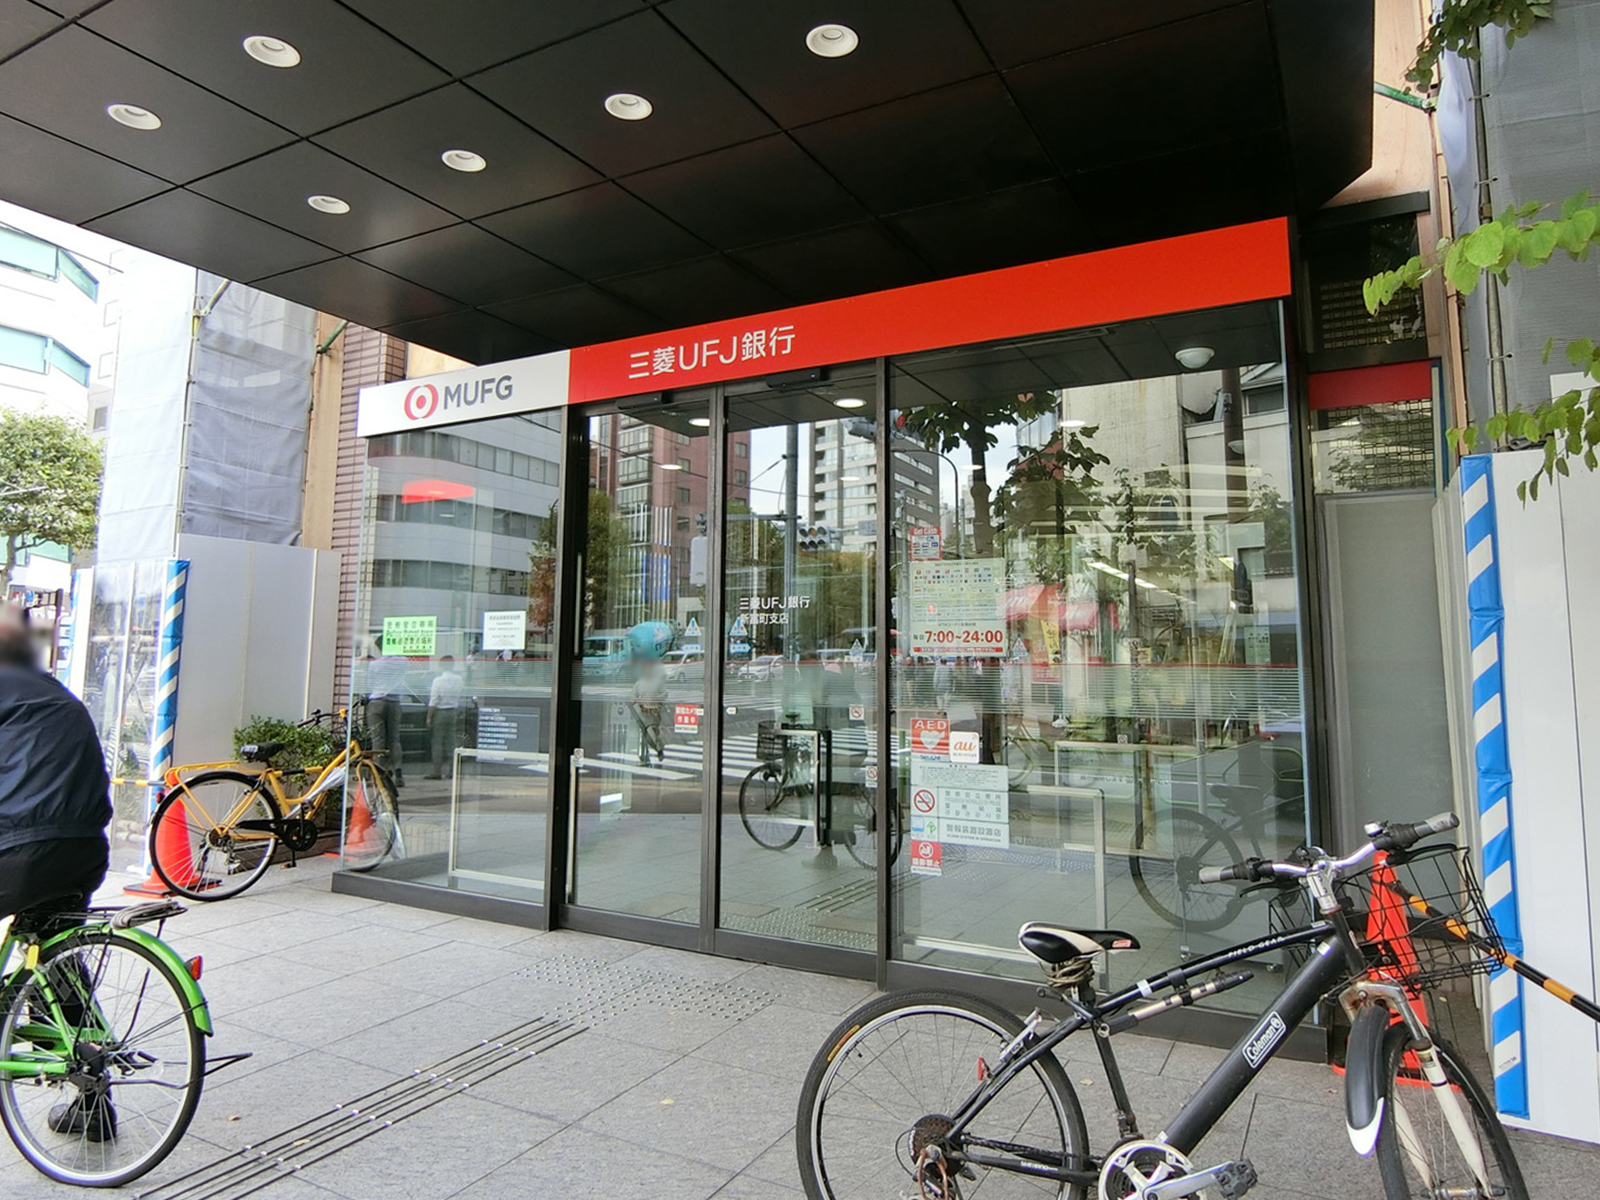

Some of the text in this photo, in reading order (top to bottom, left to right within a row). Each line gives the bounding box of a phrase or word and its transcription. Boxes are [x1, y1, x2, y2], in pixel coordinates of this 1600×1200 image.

[629, 325, 796, 379] 三菱UFJ銀行
[444, 375, 513, 410] MUFG
[740, 595, 811, 610] 三菱UFJ銀行
[915, 720, 947, 730] AED
[953, 741, 977, 751] au
[1246, 1026, 1277, 1060] Coleman
